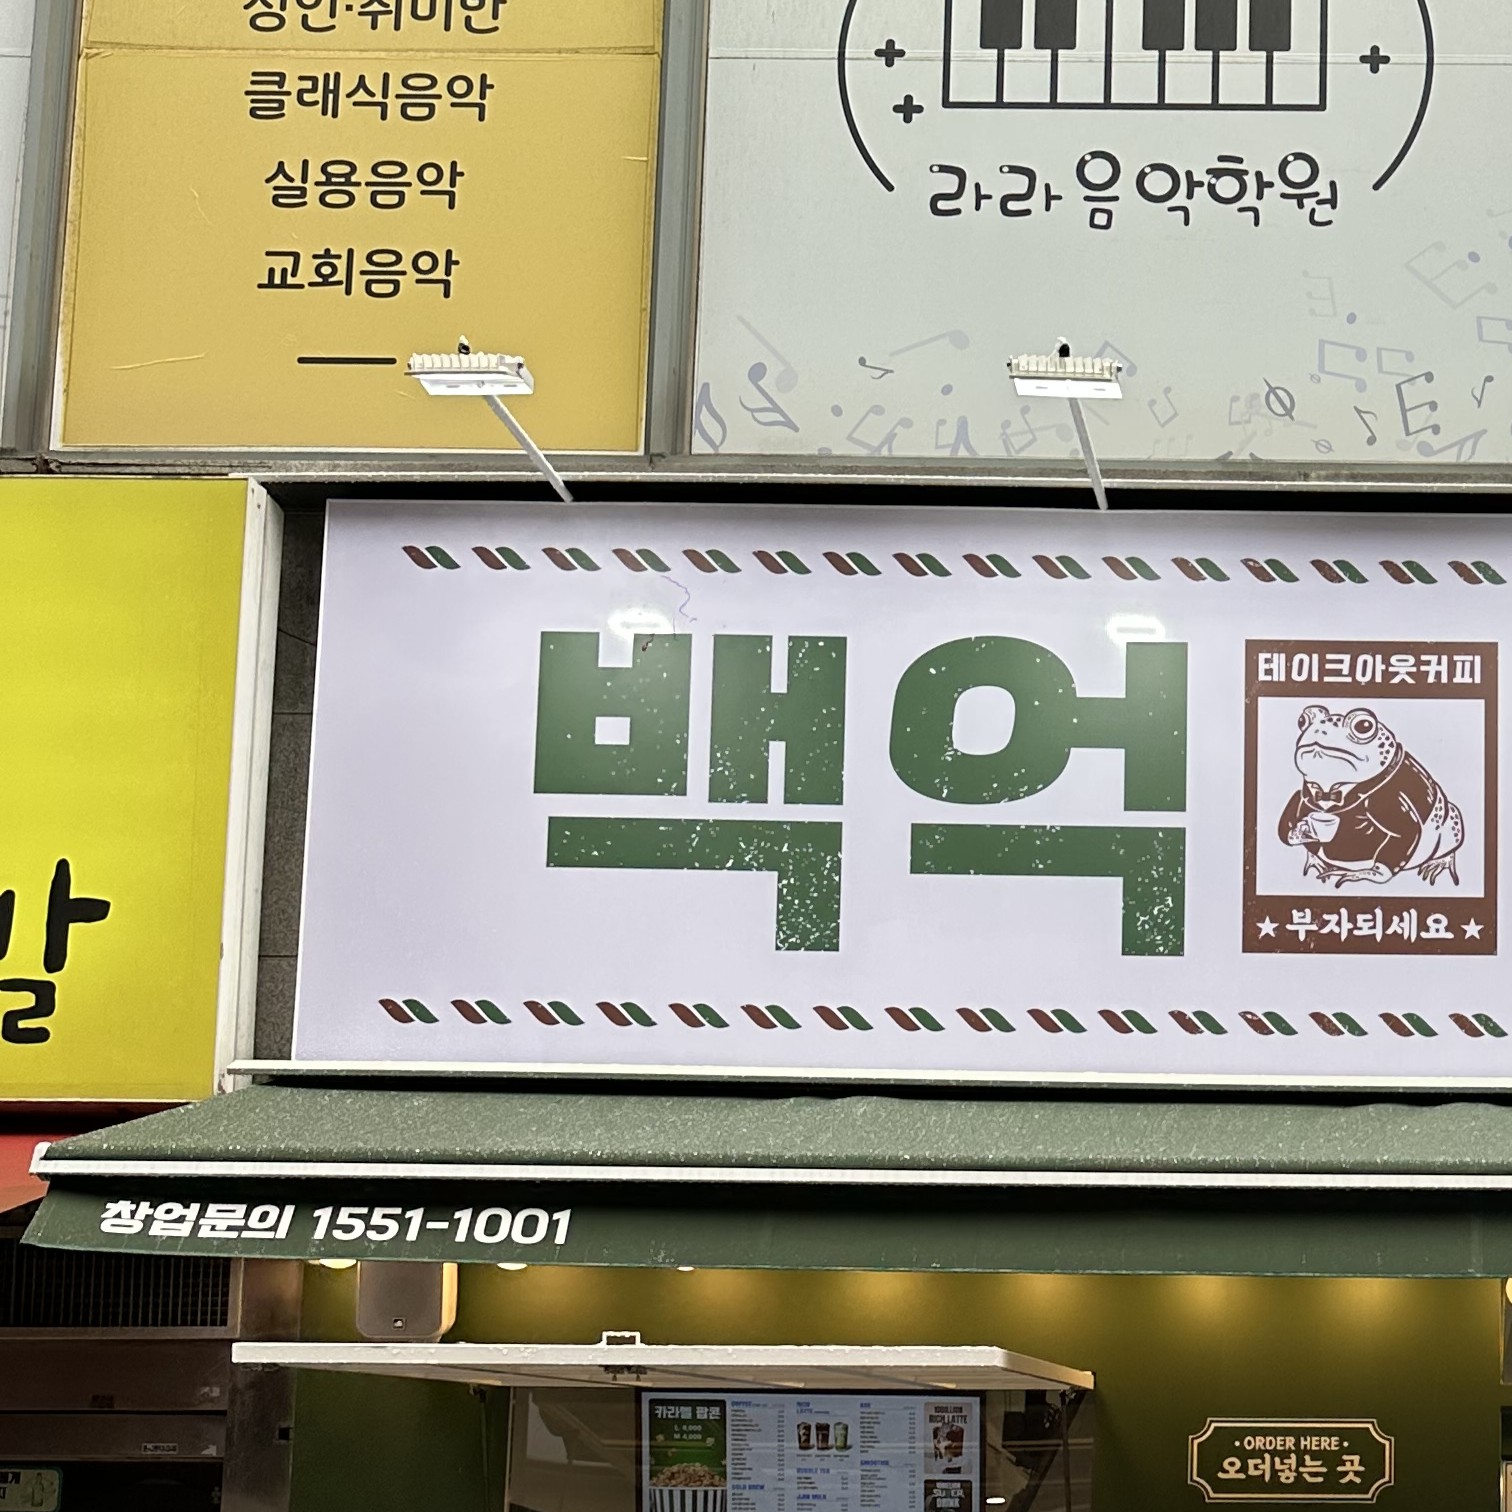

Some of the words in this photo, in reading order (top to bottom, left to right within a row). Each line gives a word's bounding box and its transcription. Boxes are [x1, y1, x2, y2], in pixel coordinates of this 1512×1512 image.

[244, 70, 495, 122] 클래식음악
[264, 158, 465, 211] 실용음악
[929, 149, 1339, 231] 라라음악학원
[256, 245, 461, 300] 교회음악
[1257, 652, 1481, 684] 테이크아웃커피
[533, 630, 1188, 957] 백억
[1285, 908, 1455, 943] 부자되세요
[99, 1200, 296, 1240] 창업문의
[311, 1206, 573, 1246] 1551-1001
[1243, 1436, 1296, 1450] ORDER
[1299, 1436, 1340, 1450] HERE
[1217, 1453, 1328, 1484] 오더넣는
[1336, 1454, 1366, 1484] 곳
